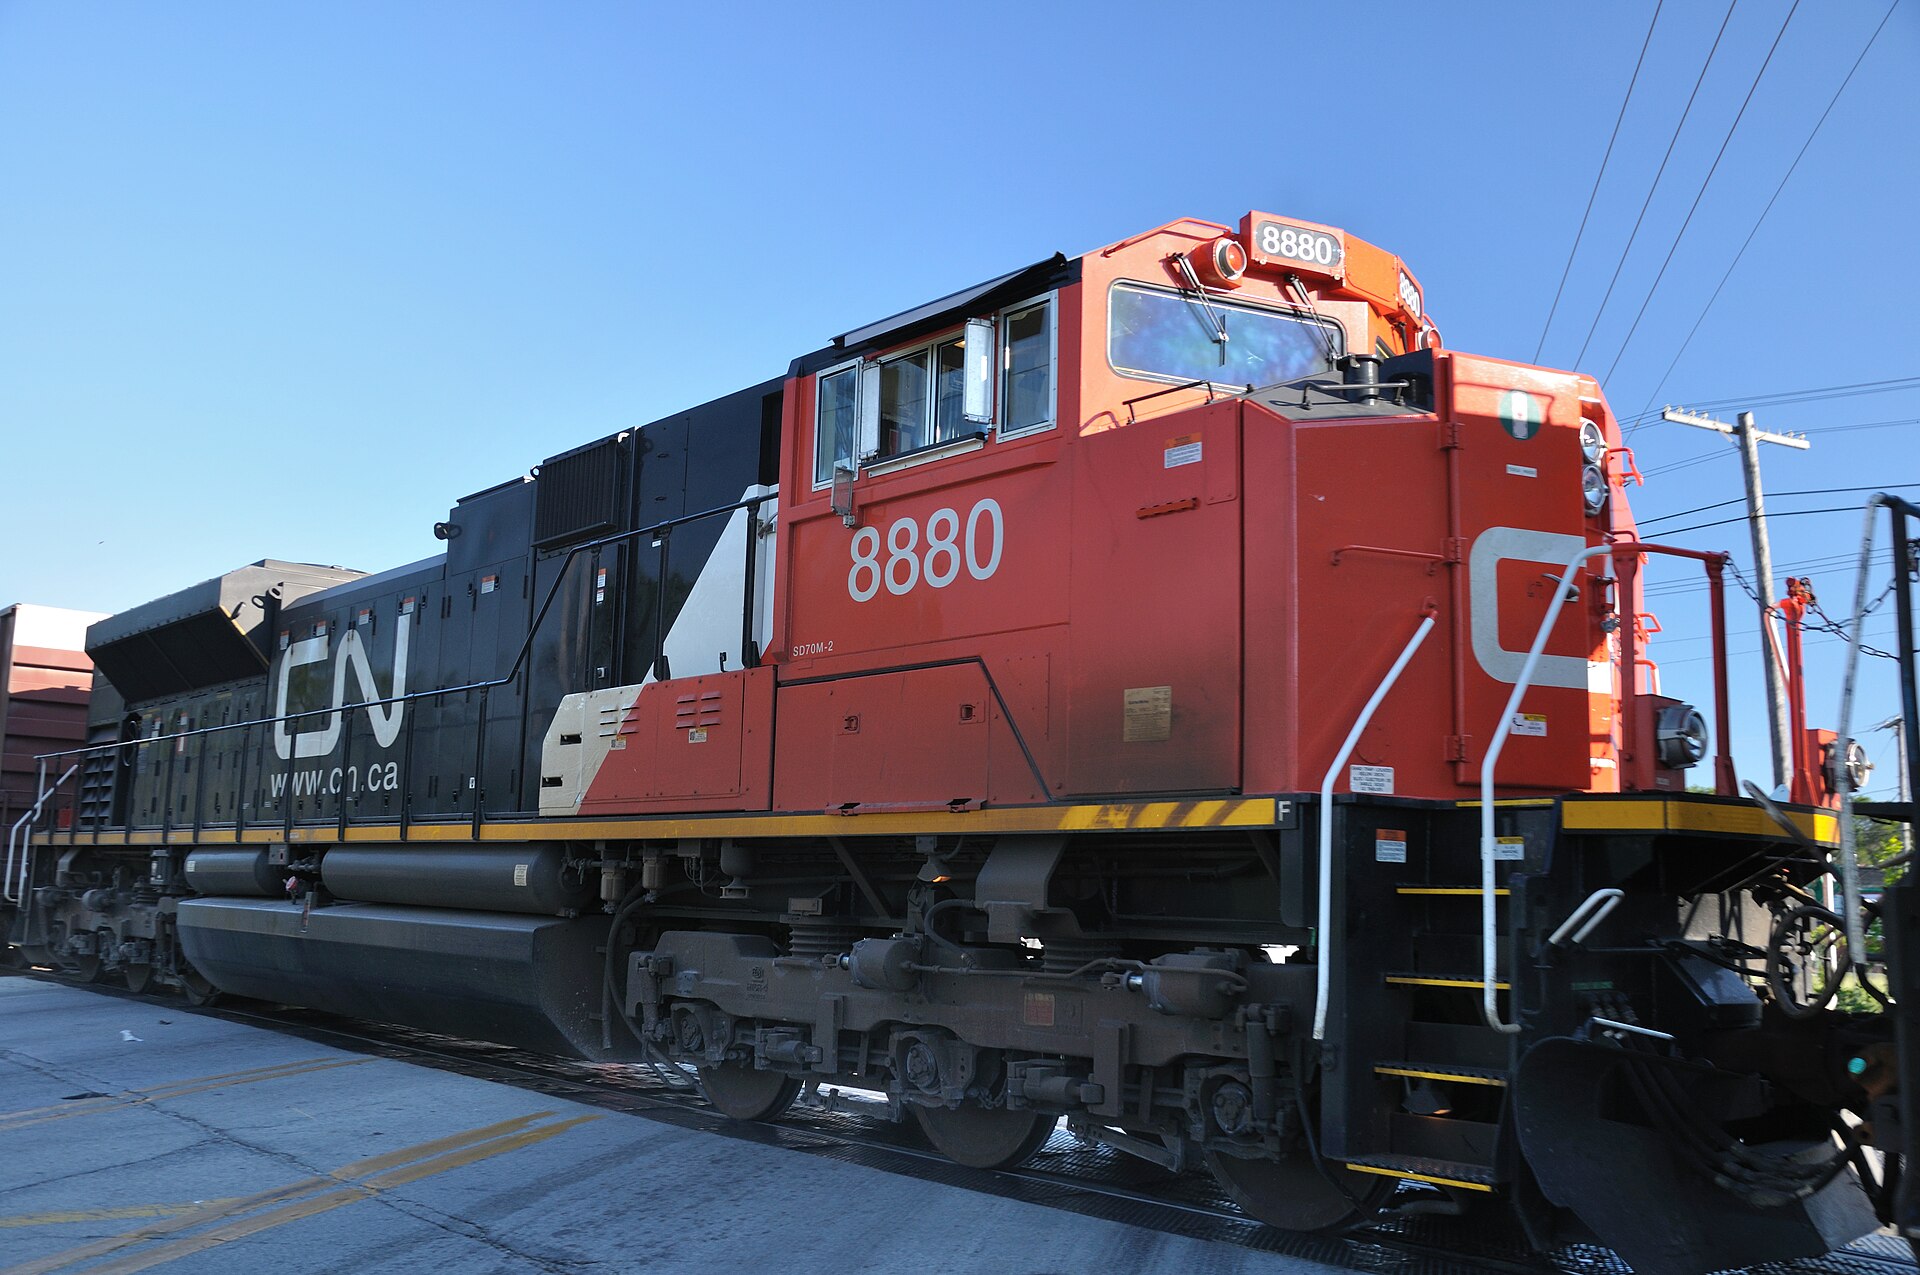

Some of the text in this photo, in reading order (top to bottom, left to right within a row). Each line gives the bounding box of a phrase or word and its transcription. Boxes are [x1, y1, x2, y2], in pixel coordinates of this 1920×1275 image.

[1262, 227, 1331, 265] 8880
[848, 499, 1003, 602] 8880
[793, 641, 833, 656] SD70M-2
[274, 614, 411, 761] CN
[271, 761, 398, 798] www.cn.ca
[1279, 801, 1291, 820] F
